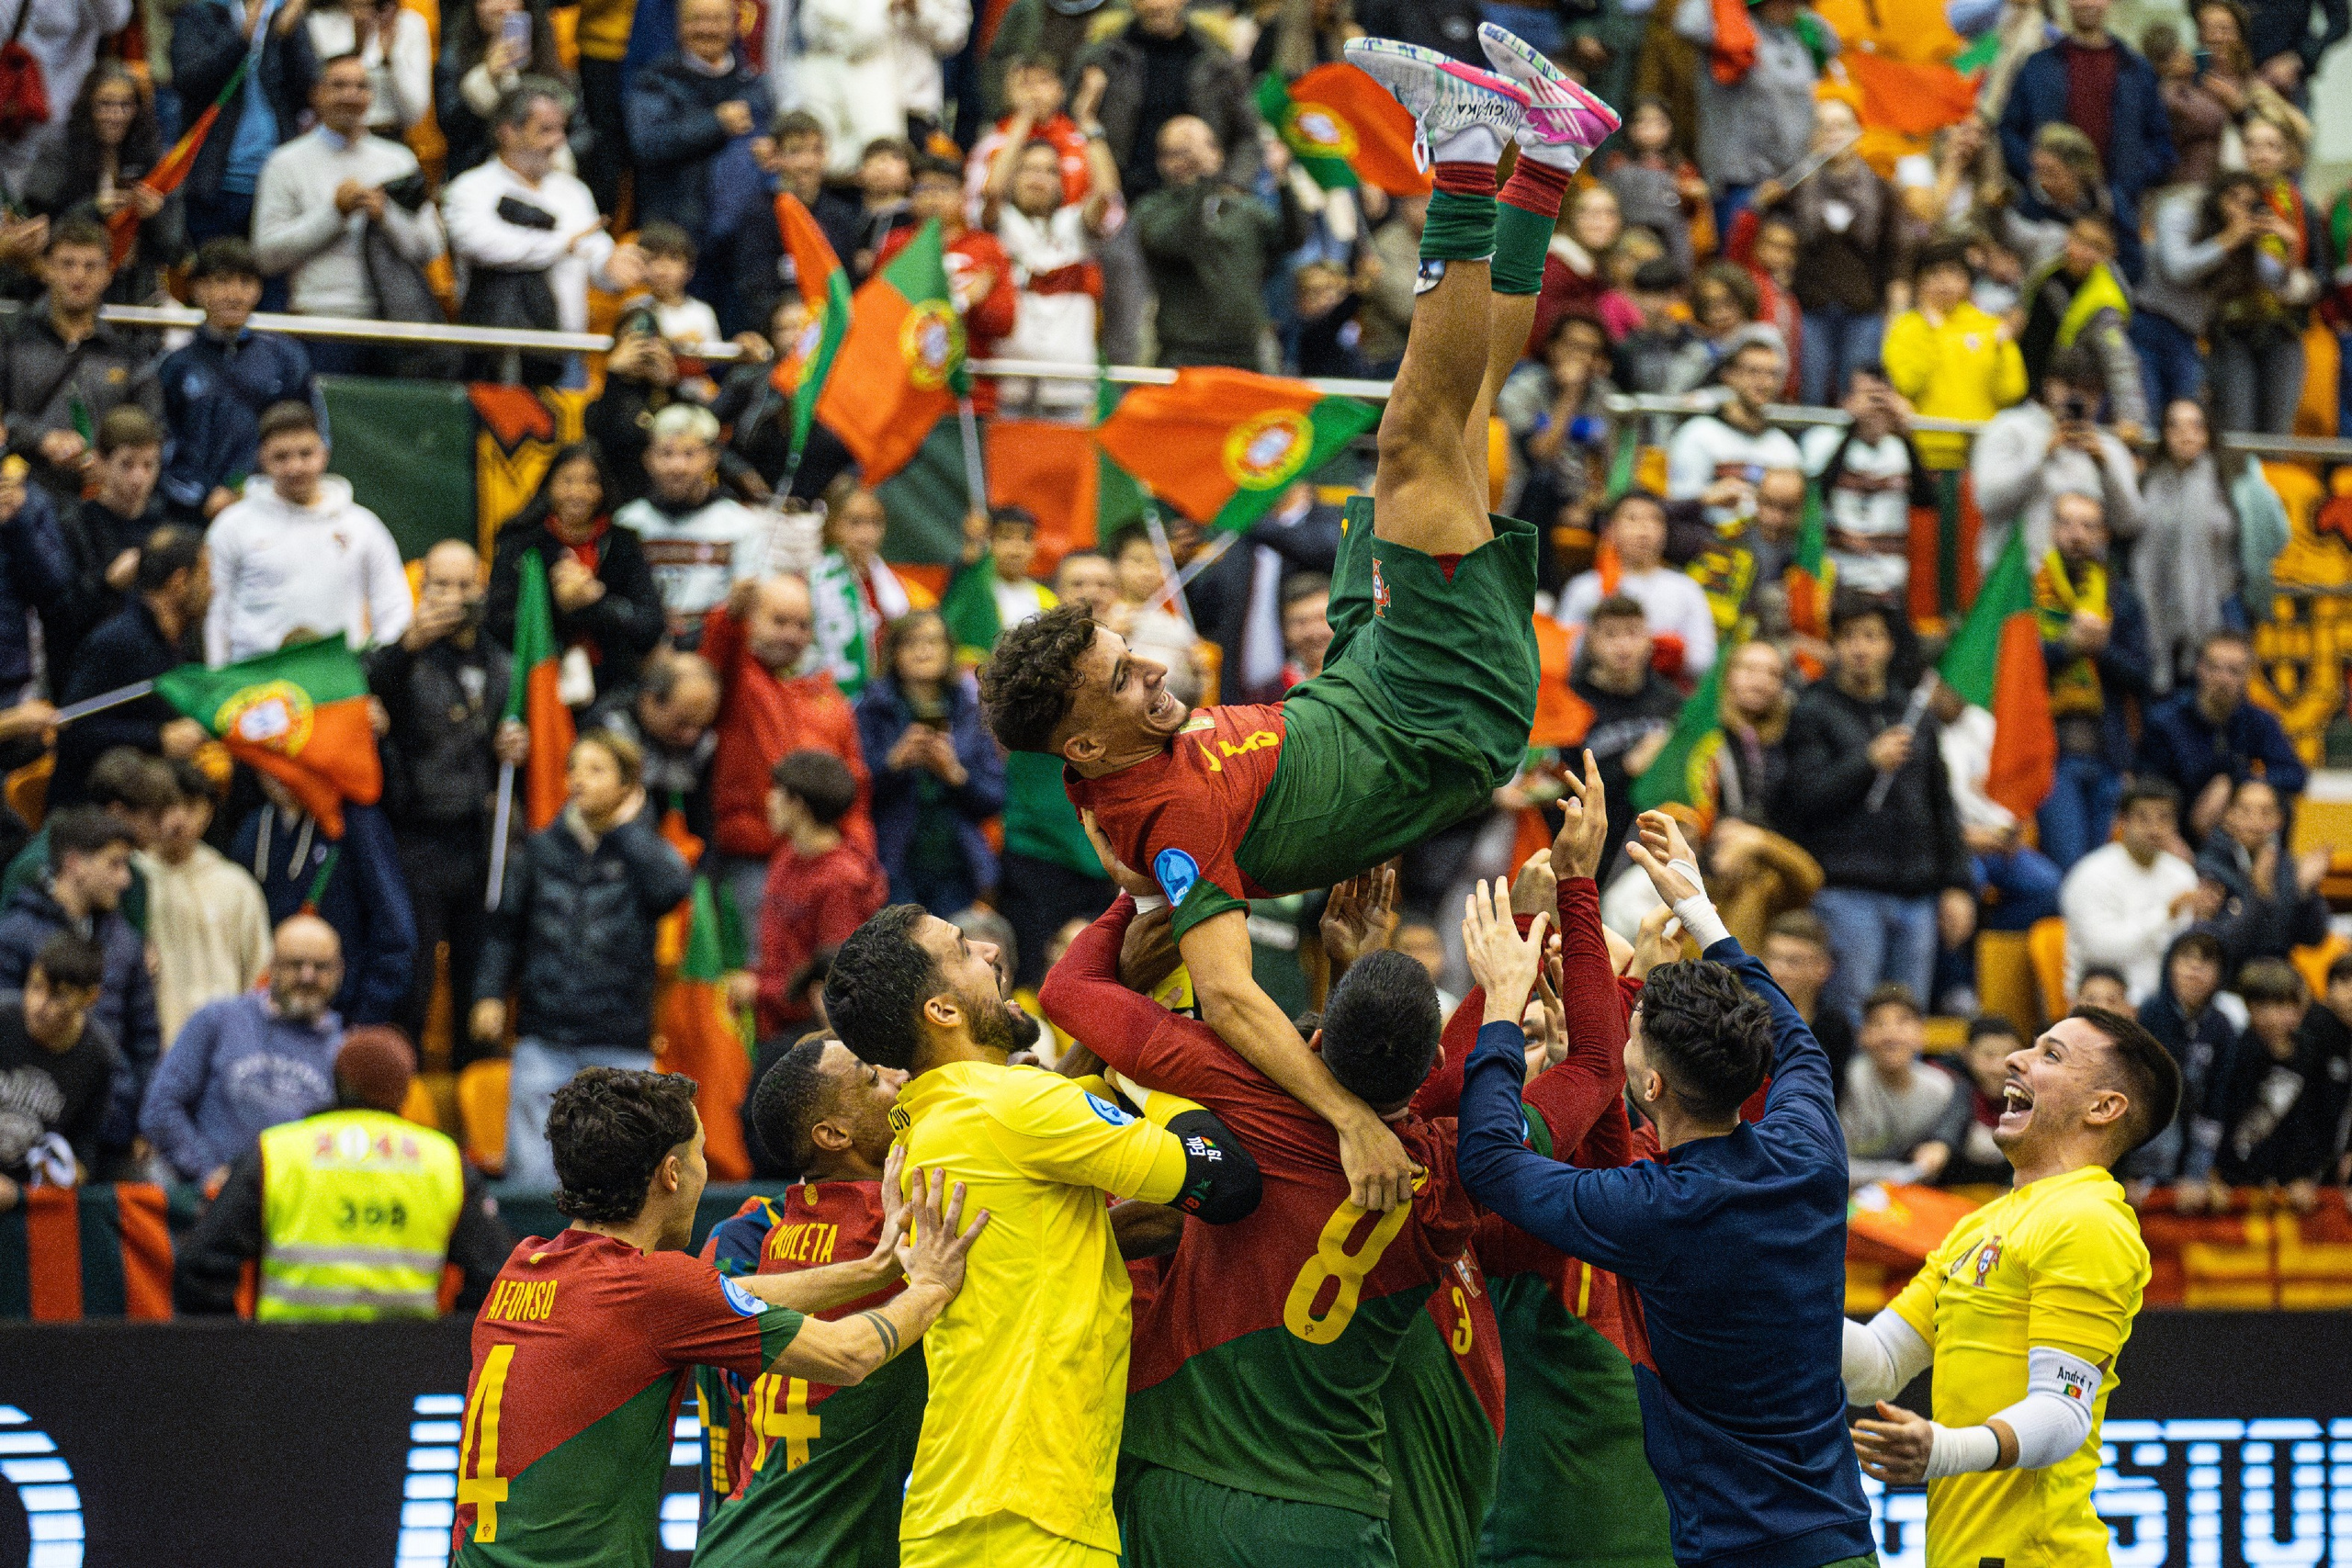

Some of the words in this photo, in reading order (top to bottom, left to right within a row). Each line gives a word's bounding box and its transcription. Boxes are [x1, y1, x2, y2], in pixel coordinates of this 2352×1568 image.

[1186, 1135, 1206, 1156] Edu
[1206, 1149, 1222, 1163] 19
[769, 1223, 839, 1263] PAULETA
[1283, 1194, 1413, 1345] 8
[485, 1280, 558, 1321] AFONSO
[1452, 1286, 1473, 1355] 3
[2056, 1366, 2086, 1388] André
[751, 1372, 820, 1473] 14
[458, 1345, 516, 1543] 4
